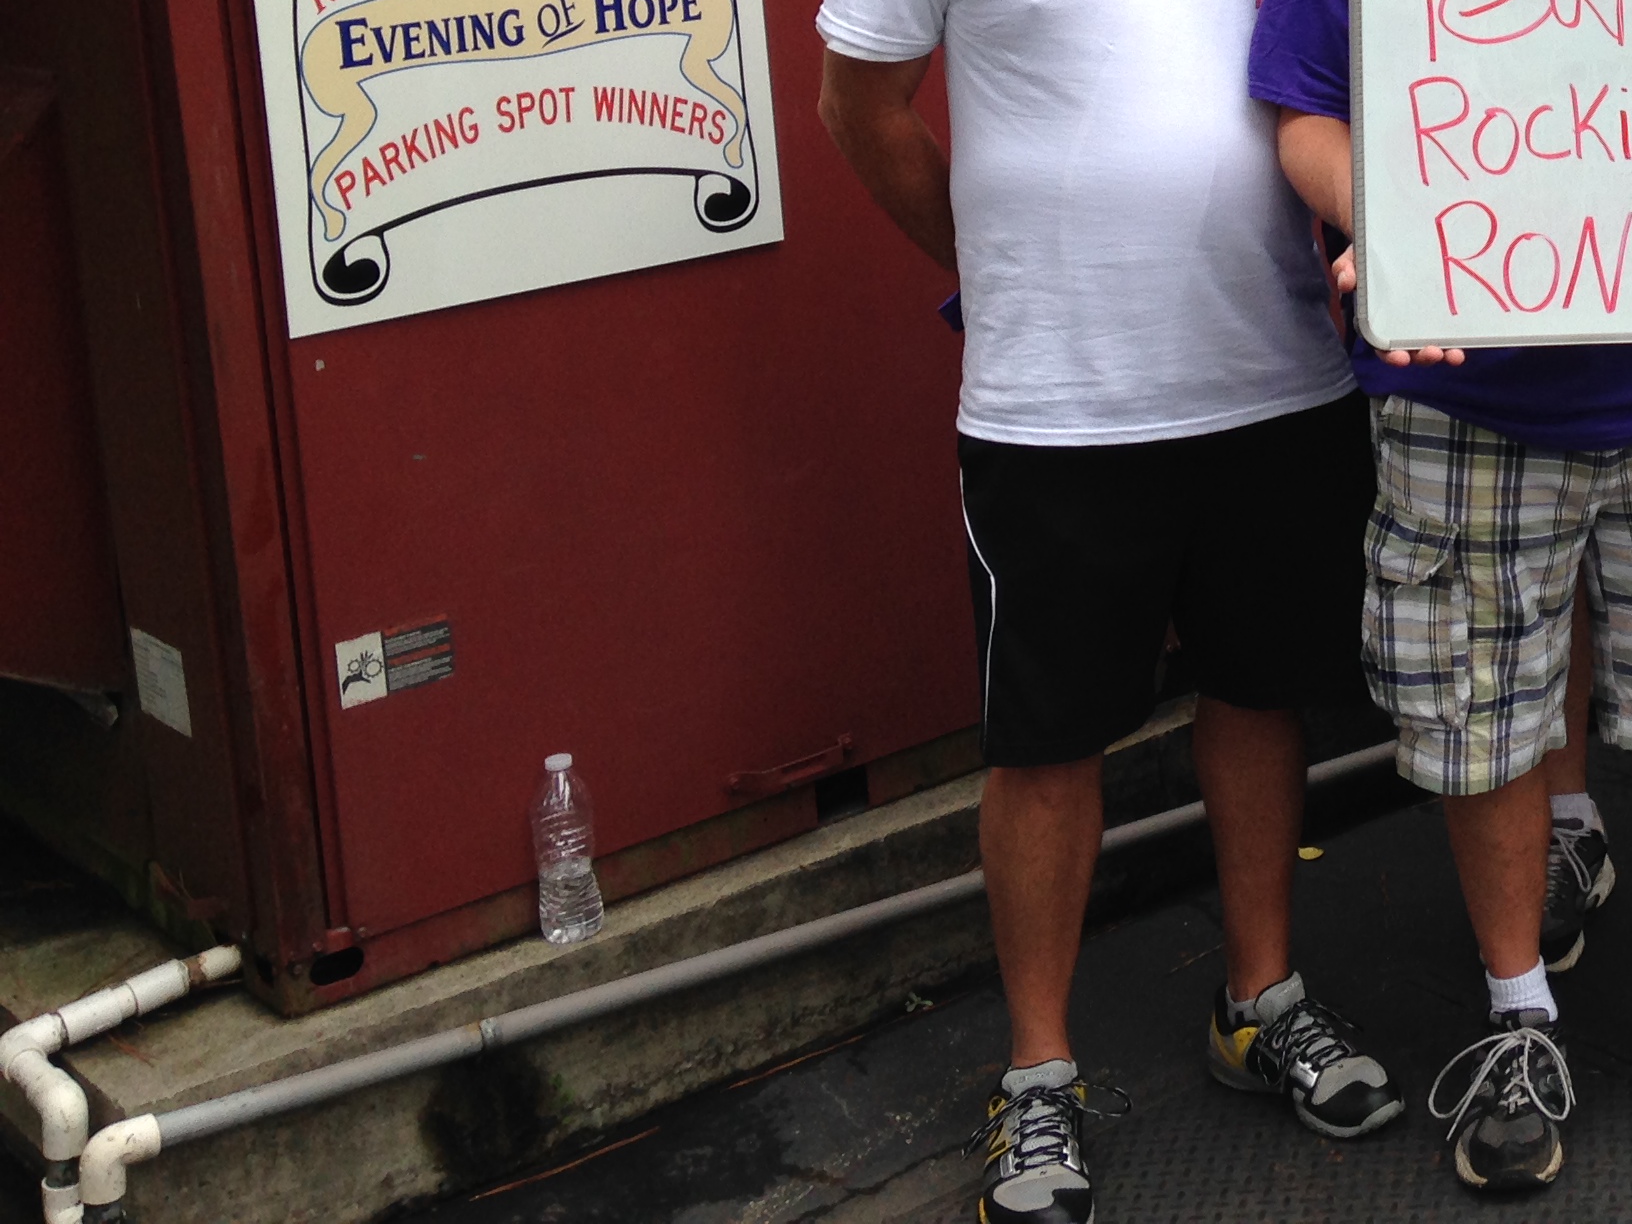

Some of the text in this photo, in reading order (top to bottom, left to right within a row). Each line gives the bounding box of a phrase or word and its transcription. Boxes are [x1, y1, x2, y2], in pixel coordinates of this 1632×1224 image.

[335, 9, 525, 70] EVENING
[334, 86, 727, 210] PARKING SPOT WINNERS
